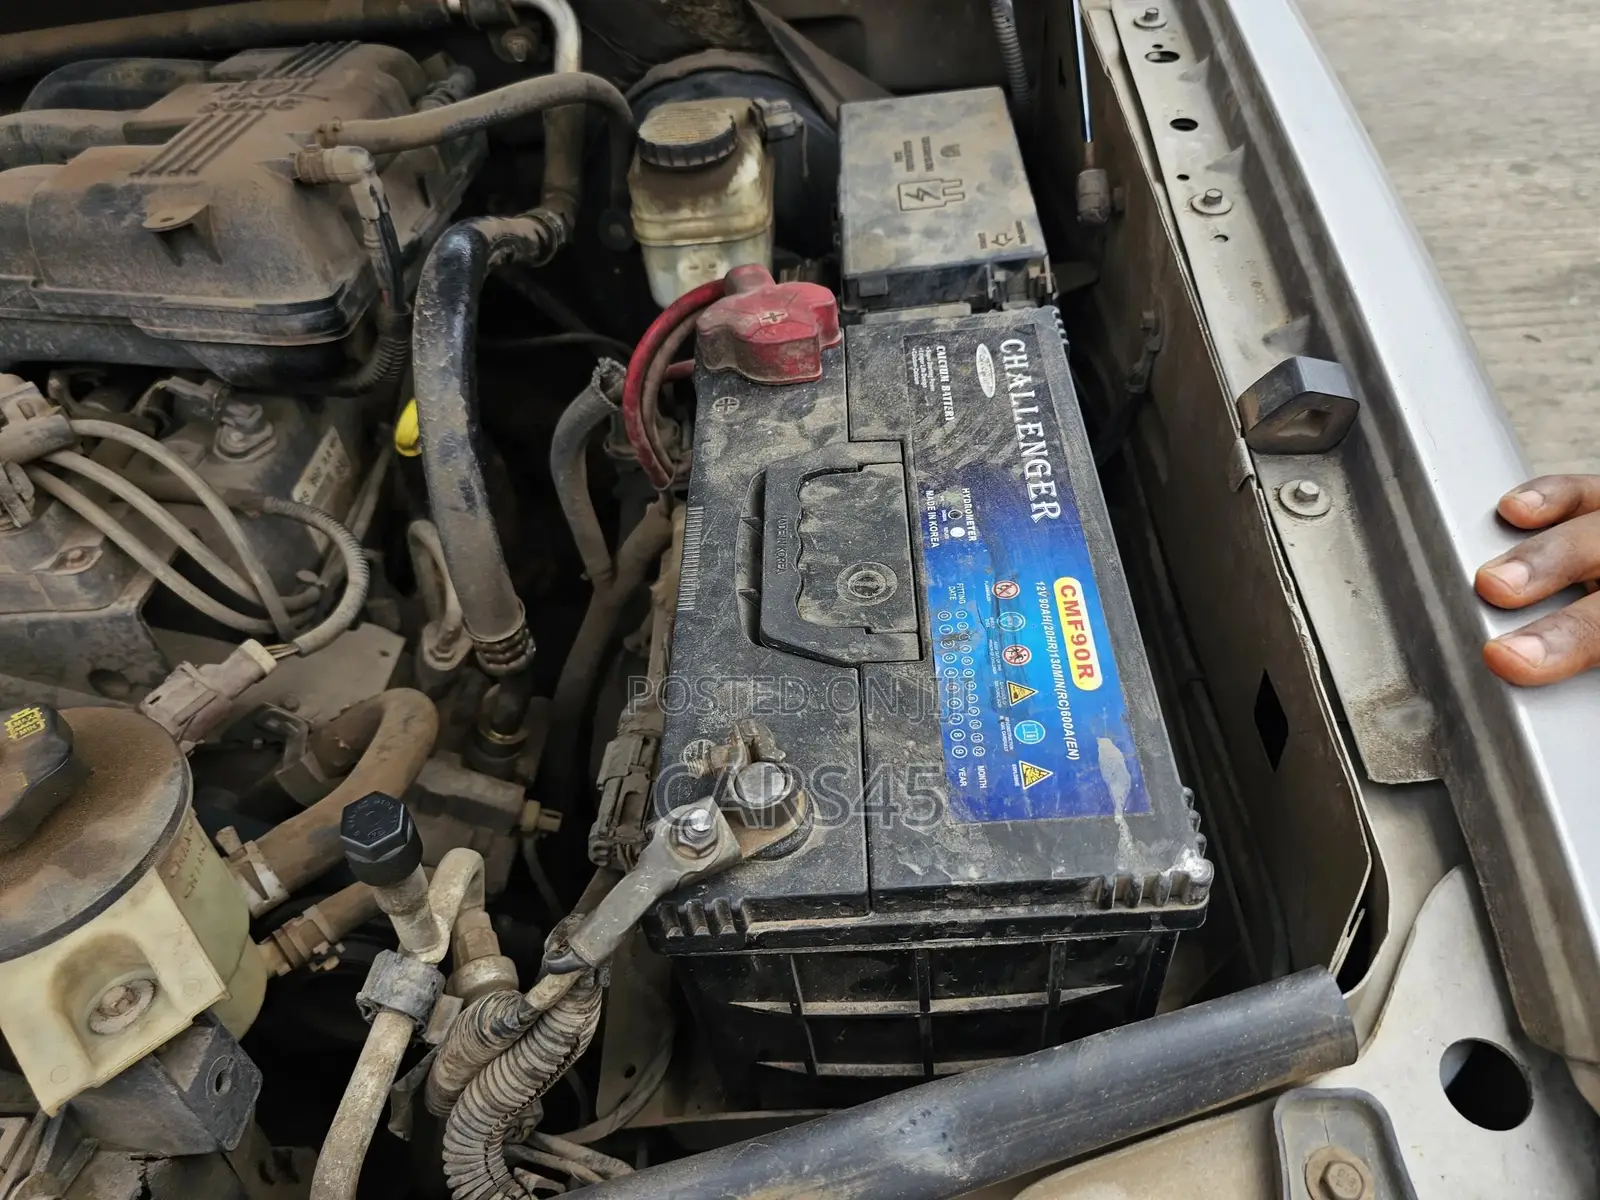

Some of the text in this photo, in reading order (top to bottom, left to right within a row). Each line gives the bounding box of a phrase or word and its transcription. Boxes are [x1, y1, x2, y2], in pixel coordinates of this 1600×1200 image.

[936, 345, 950, 382] CALCIUM
[1000, 339, 1061, 523] CHALLENGER
[926, 490, 940, 548] MADE IN KOREA
[962, 488, 977, 541] HYDROMETER
[948, 586, 957, 600] DATE
[956, 583, 966, 604] FITTING
[1035, 580, 1047, 598] 12V
[1060, 584, 1095, 680] CMF90R
[958, 767, 967, 786] YEAR
[977, 765, 987, 788] MONTH
